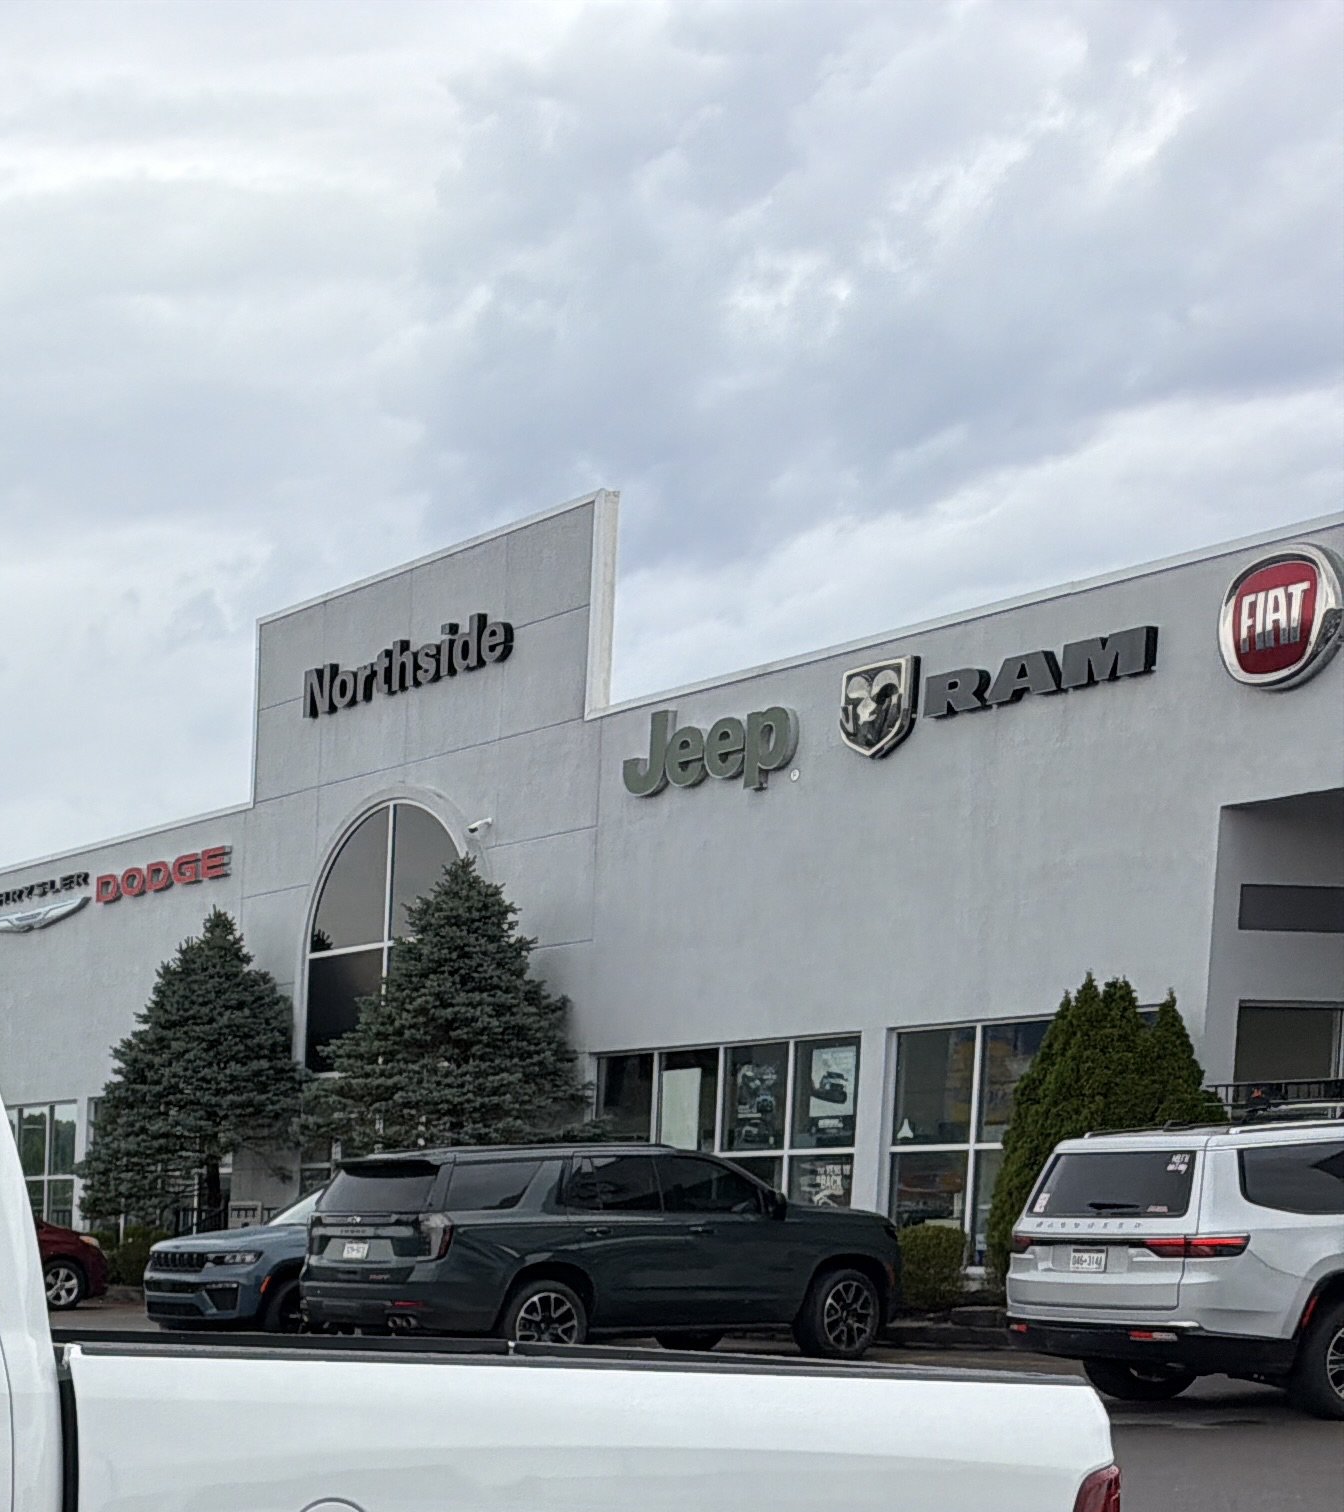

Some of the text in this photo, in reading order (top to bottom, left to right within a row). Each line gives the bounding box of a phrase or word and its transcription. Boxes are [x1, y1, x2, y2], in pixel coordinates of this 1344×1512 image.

[1240, 581, 1310, 654] FIAT
[303, 613, 515, 719] Northside
[923, 626, 1158, 719] RAM
[623, 706, 799, 798] Jeep
[96, 845, 233, 905] DODGE
